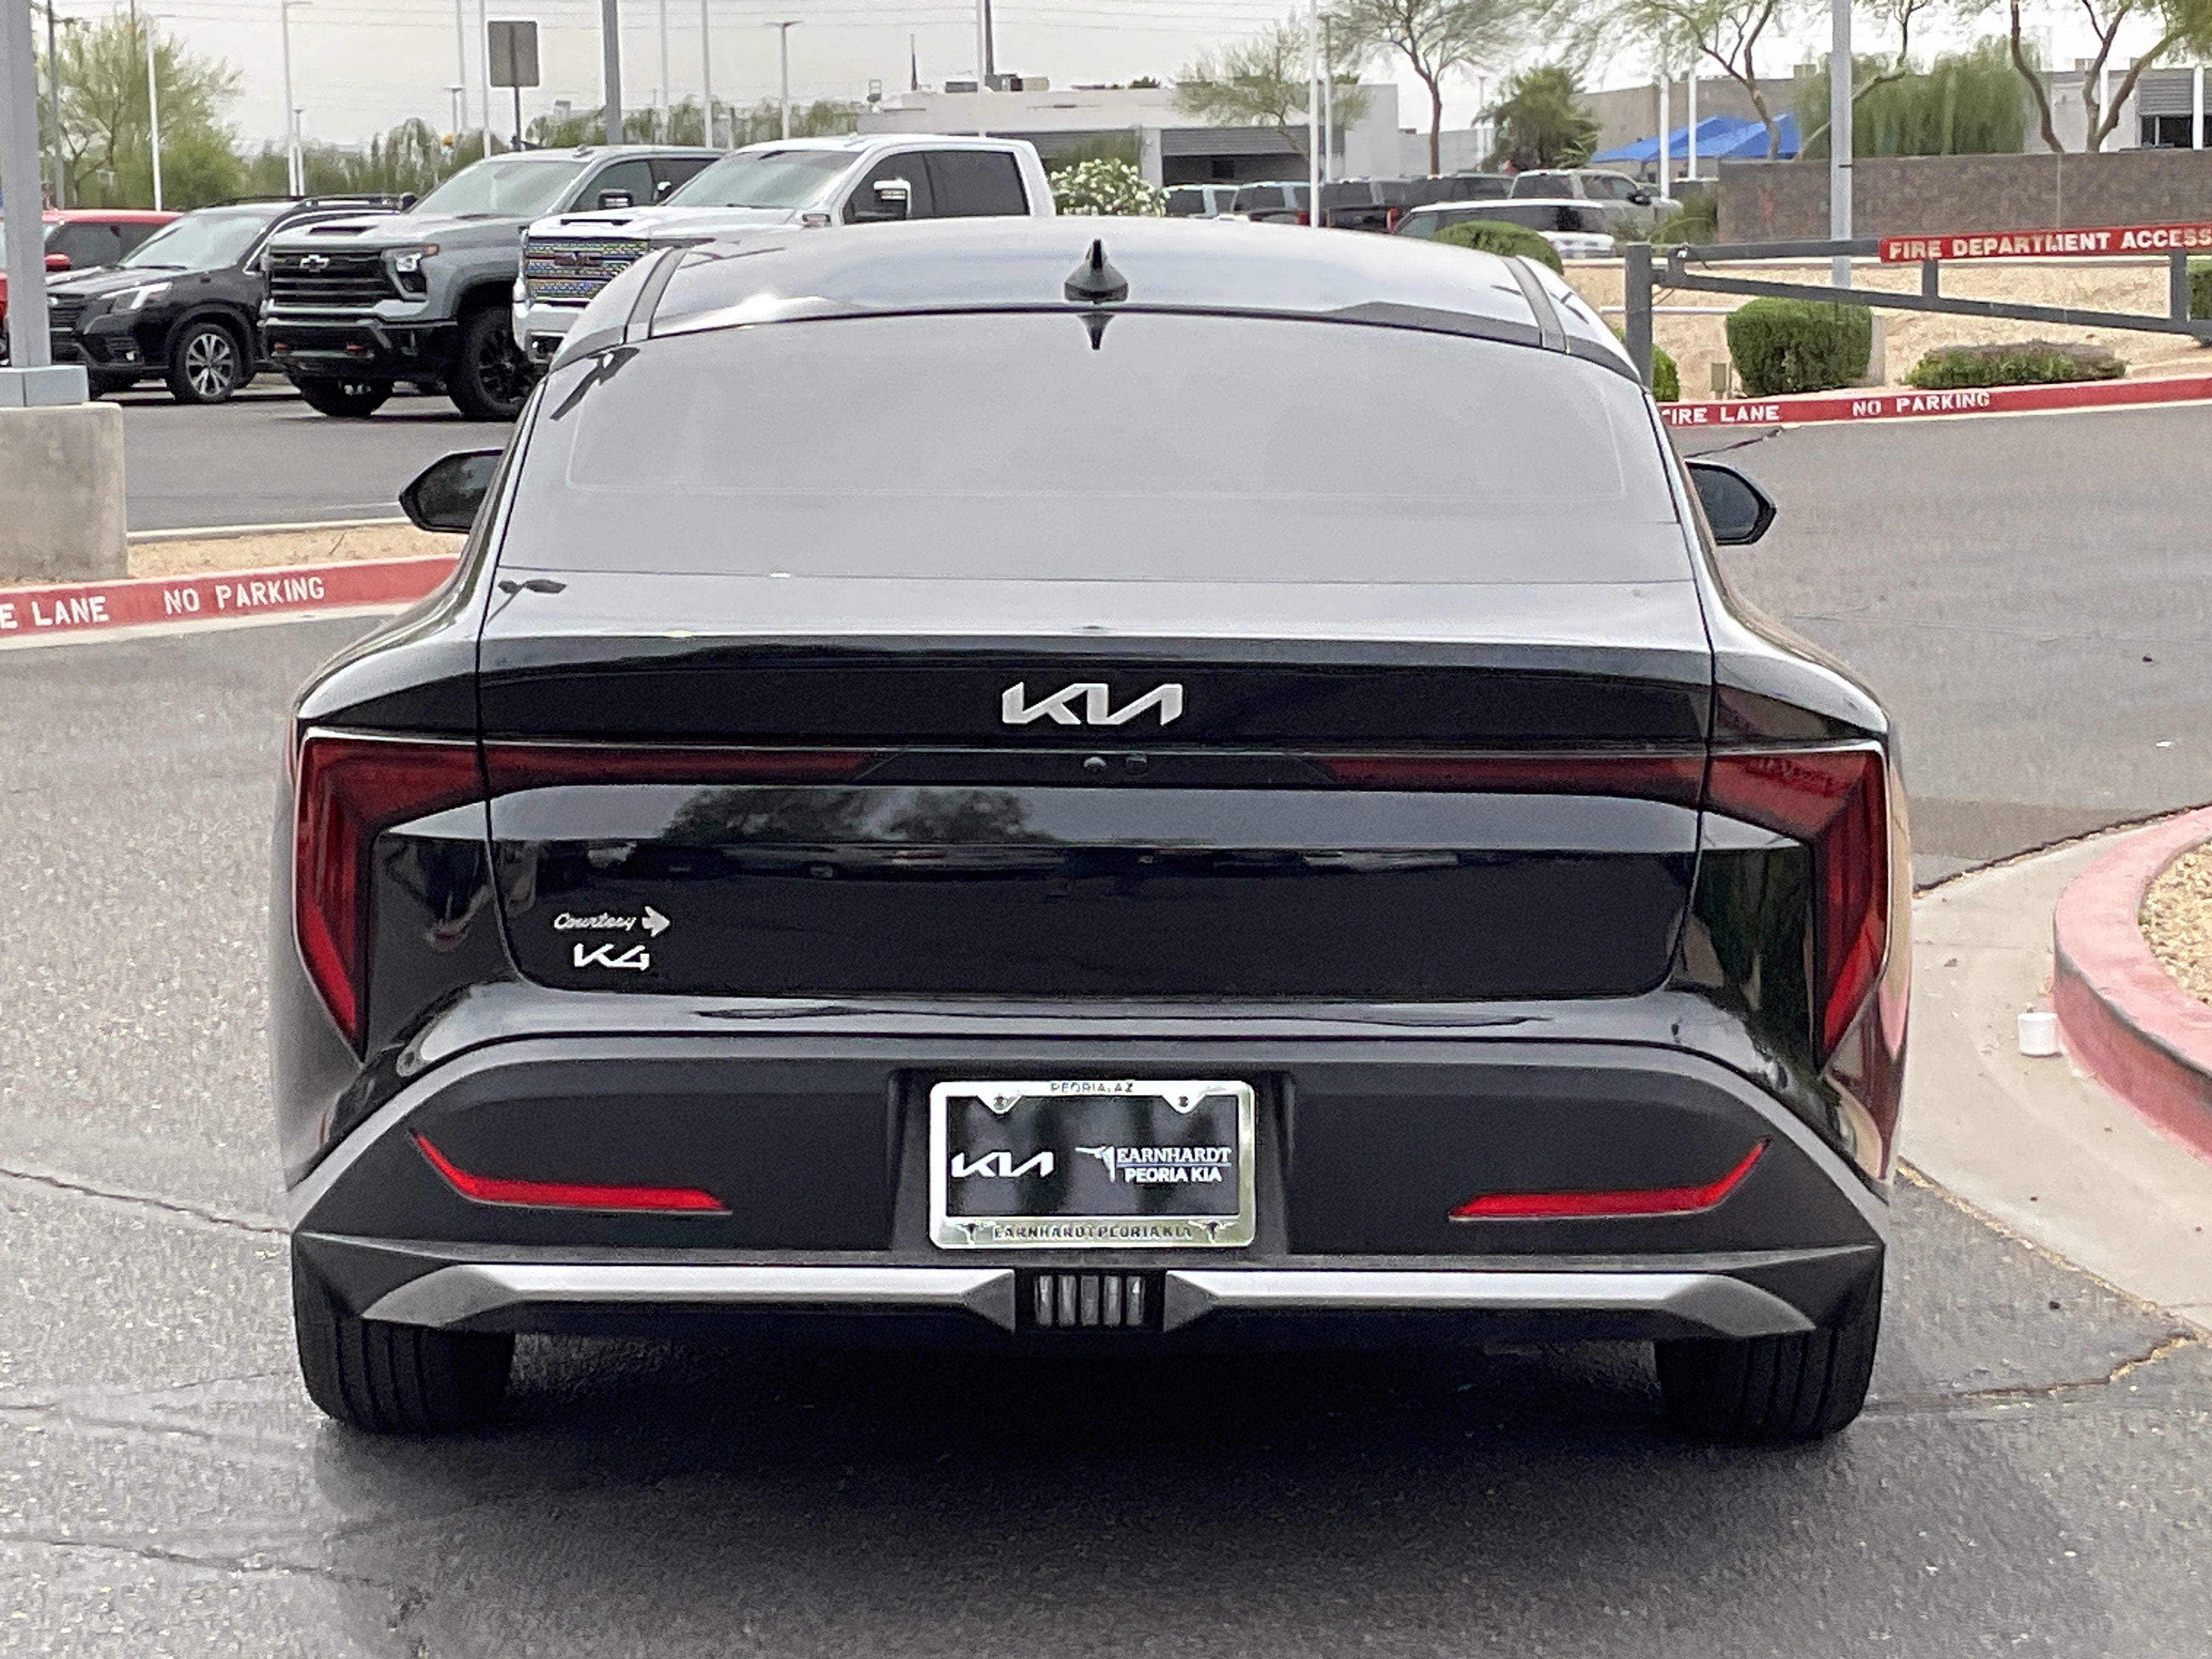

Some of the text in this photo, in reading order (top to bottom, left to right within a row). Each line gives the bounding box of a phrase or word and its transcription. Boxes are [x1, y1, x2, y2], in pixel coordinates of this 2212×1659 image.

[1889, 228, 2212, 259] FIRE DEPARTMENT ACCESS
[1720, 405, 1780, 423] LANE
[1852, 399, 1882, 416] NO
[1896, 392, 1990, 412] PARKING
[31, 596, 109, 627] LANE
[165, 588, 199, 615] NO
[216, 577, 325, 608] PARKING
[1002, 682, 1183, 726] KIA
[554, 912, 637, 930] Courtesy
[574, 943, 650, 971] K4
[1114, 1082, 1134, 1093] AZ
[951, 1151, 1054, 1178] KIA
[1116, 1147, 1232, 1163] EARNHARDT
[1125, 1167, 1222, 1183] PEORIA KIA
